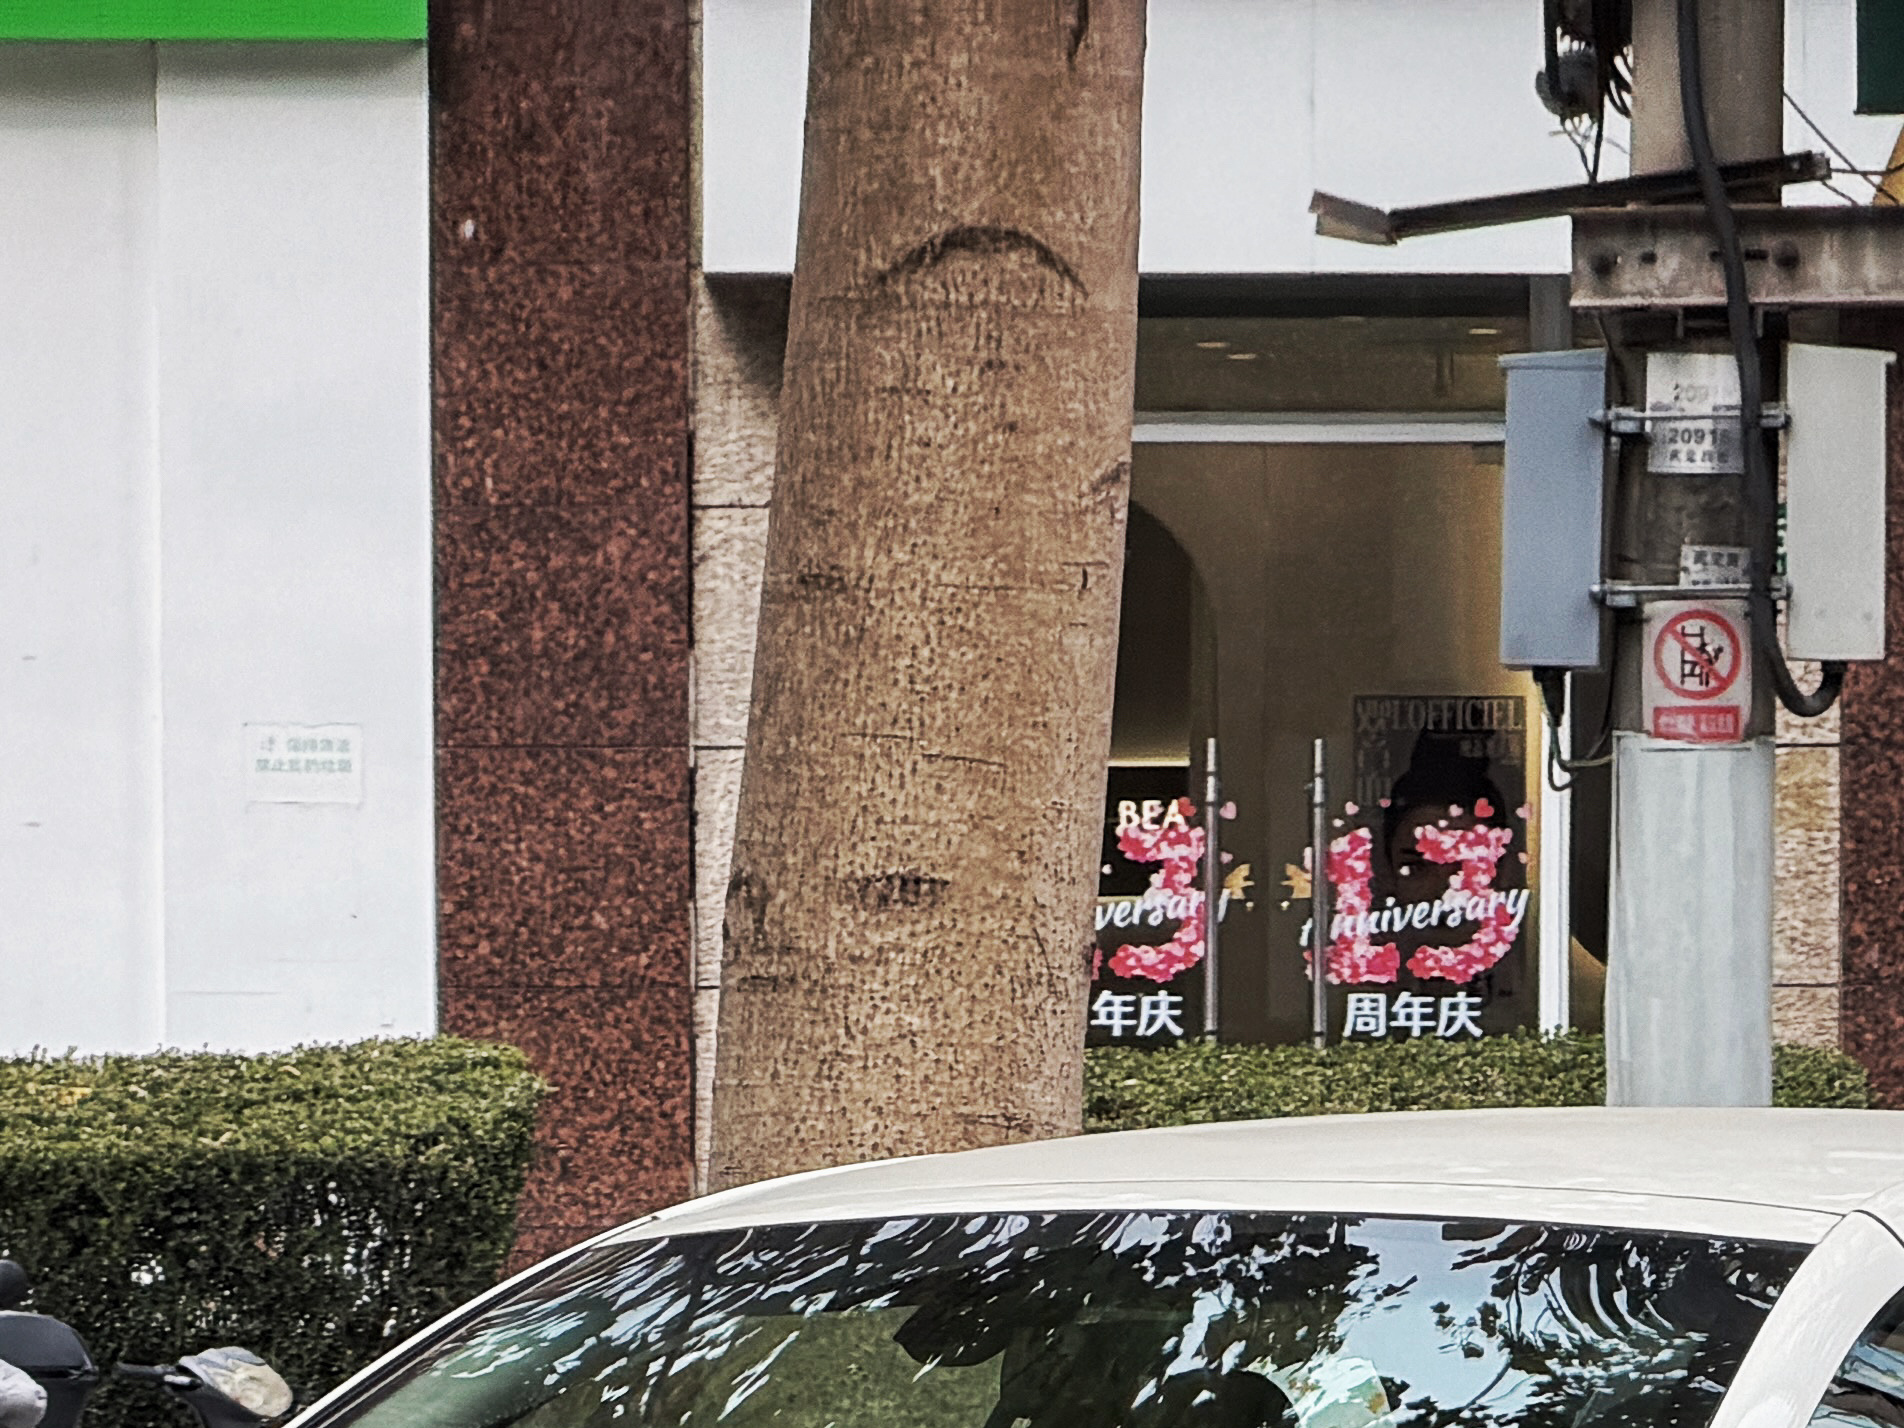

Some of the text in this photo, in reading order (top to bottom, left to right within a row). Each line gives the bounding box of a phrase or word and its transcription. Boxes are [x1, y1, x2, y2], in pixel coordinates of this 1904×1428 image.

[1090, 990, 1184, 1037] 年庆
[1342, 991, 1484, 1038] 周年庆
